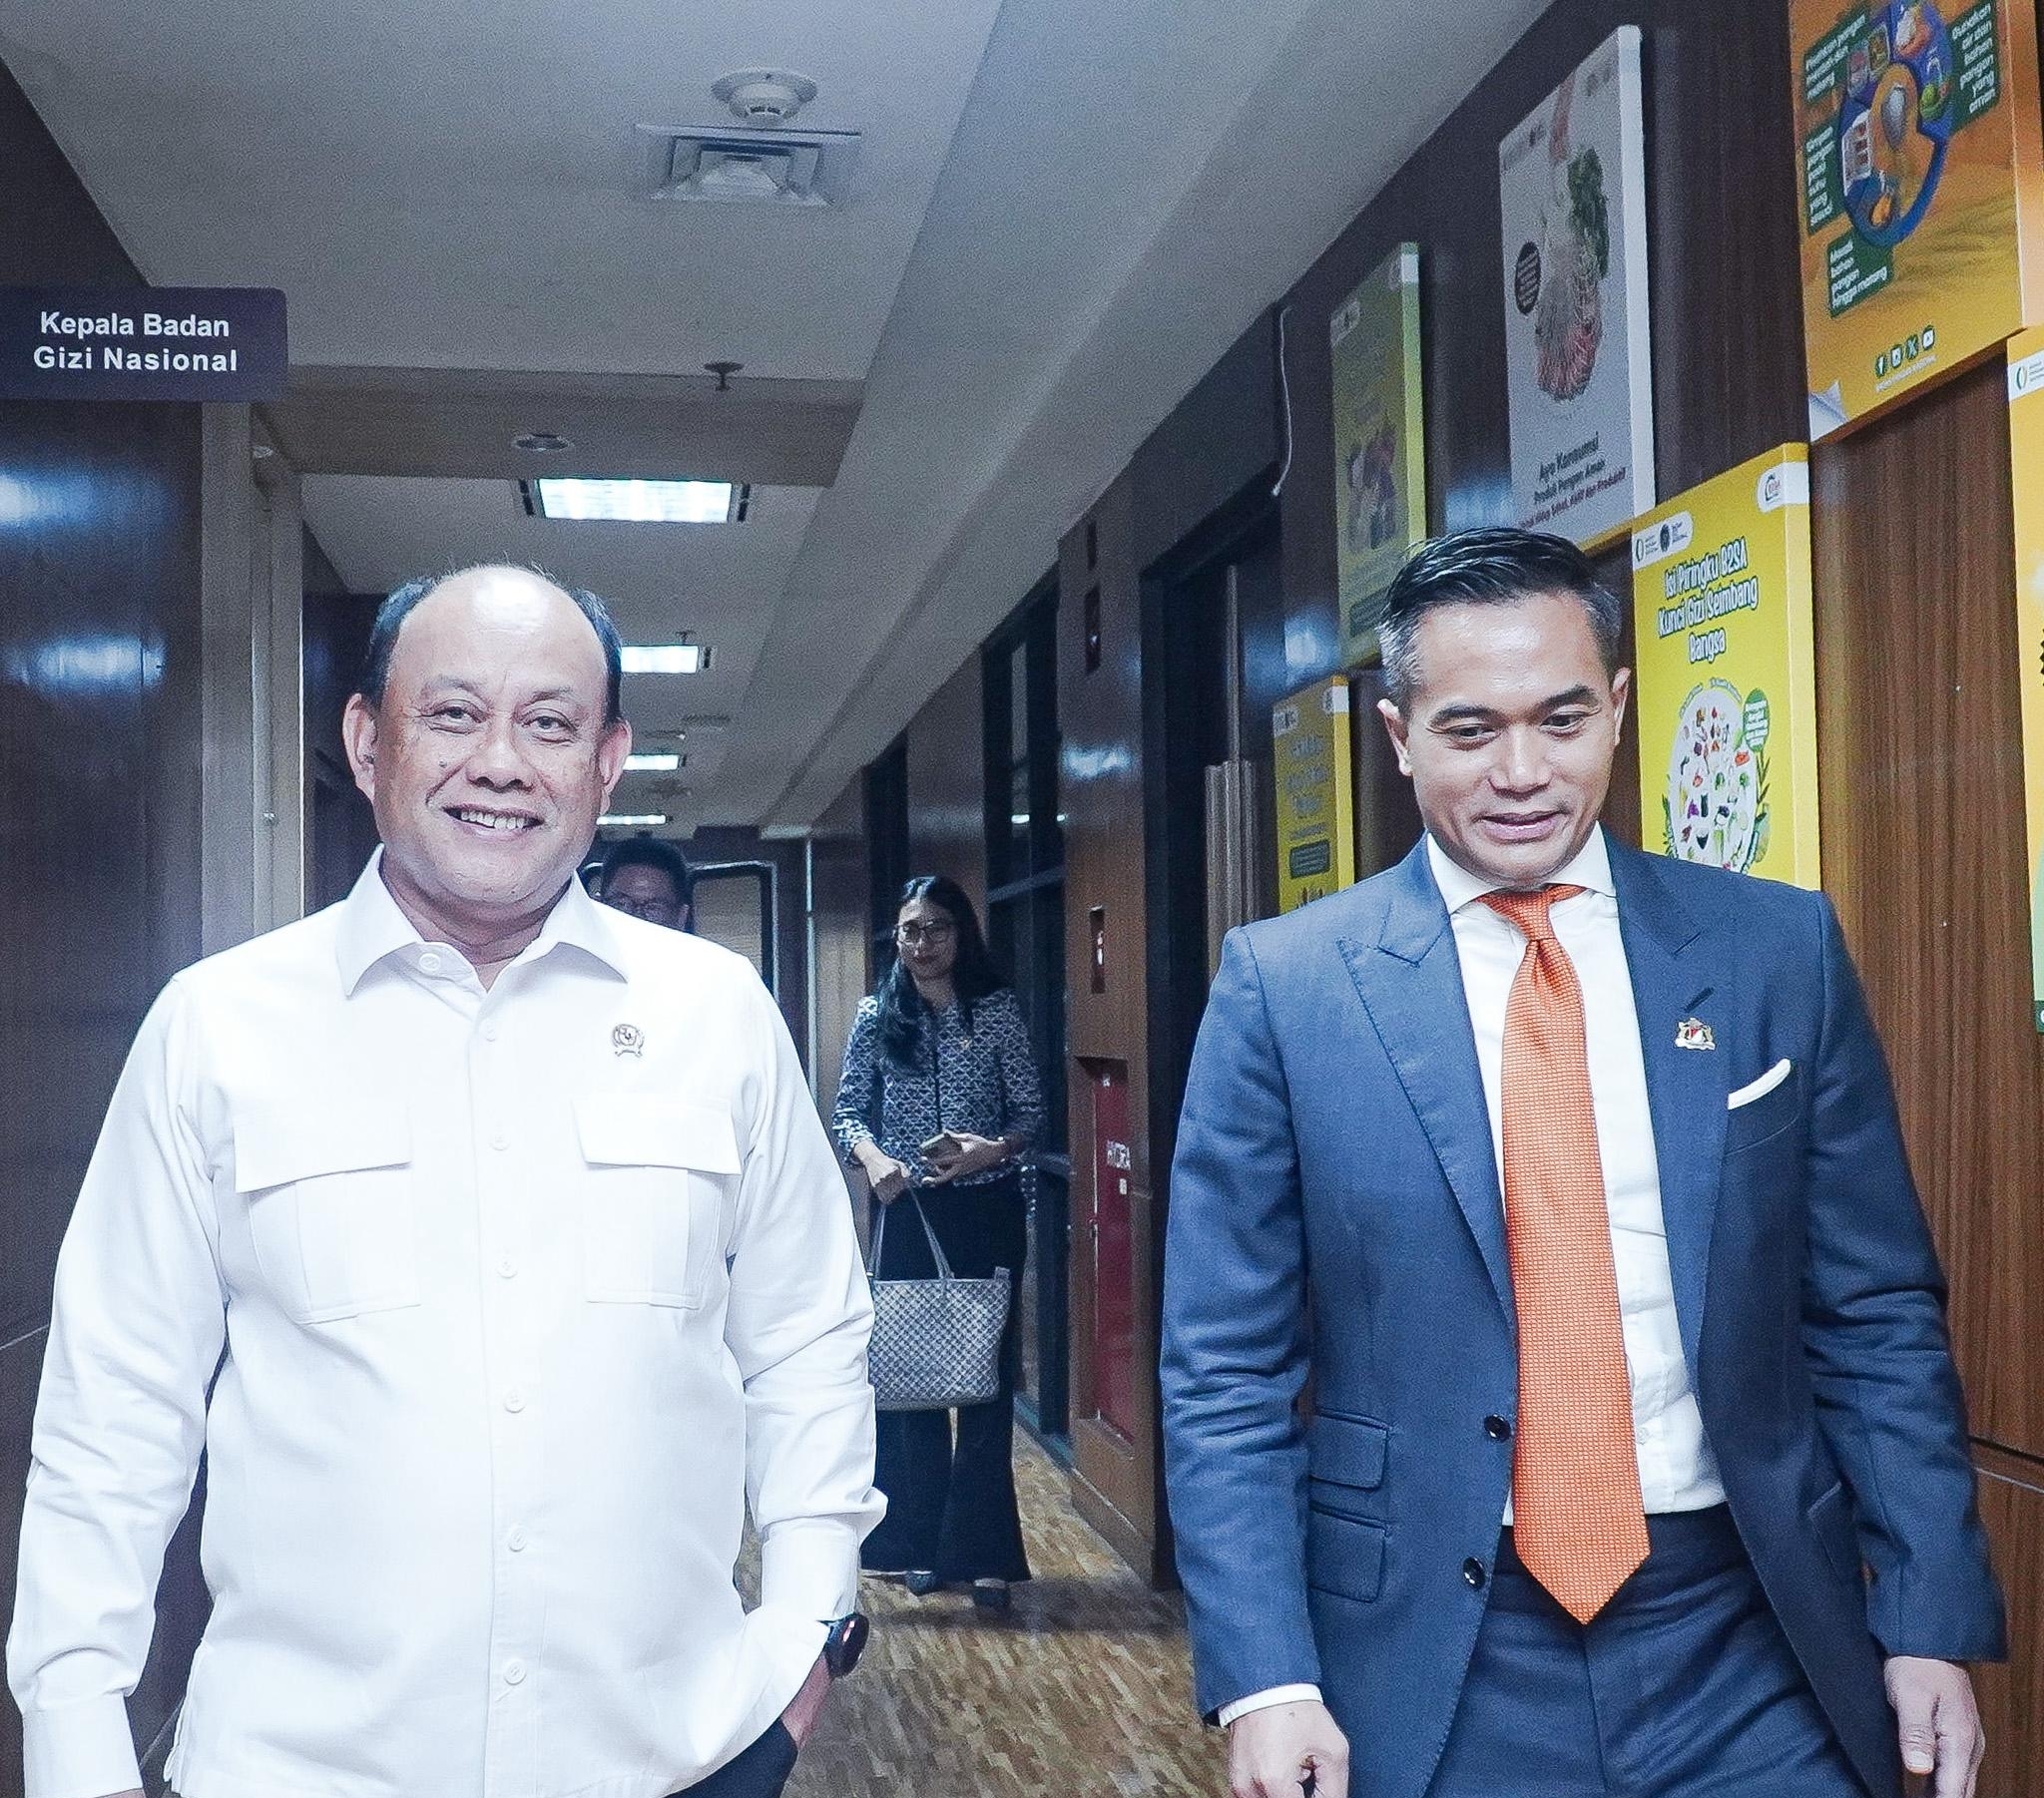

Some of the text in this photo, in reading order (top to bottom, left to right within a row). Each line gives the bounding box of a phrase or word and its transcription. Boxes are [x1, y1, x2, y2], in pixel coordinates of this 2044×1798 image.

[1960, 54, 1994, 91] pangan
[1972, 70, 1995, 99] yang
[1969, 88, 1996, 114] aman
[41, 311, 230, 339] Kepala Badan
[33, 346, 238, 372] Gizi Nasional
[1539, 461, 1556, 483] Ayo
[1665, 536, 1748, 600] Isi Piringku B2SA
[1658, 575, 1759, 639] Kunci Gizi Seimbang
[1689, 627, 1727, 664] Bangsa
